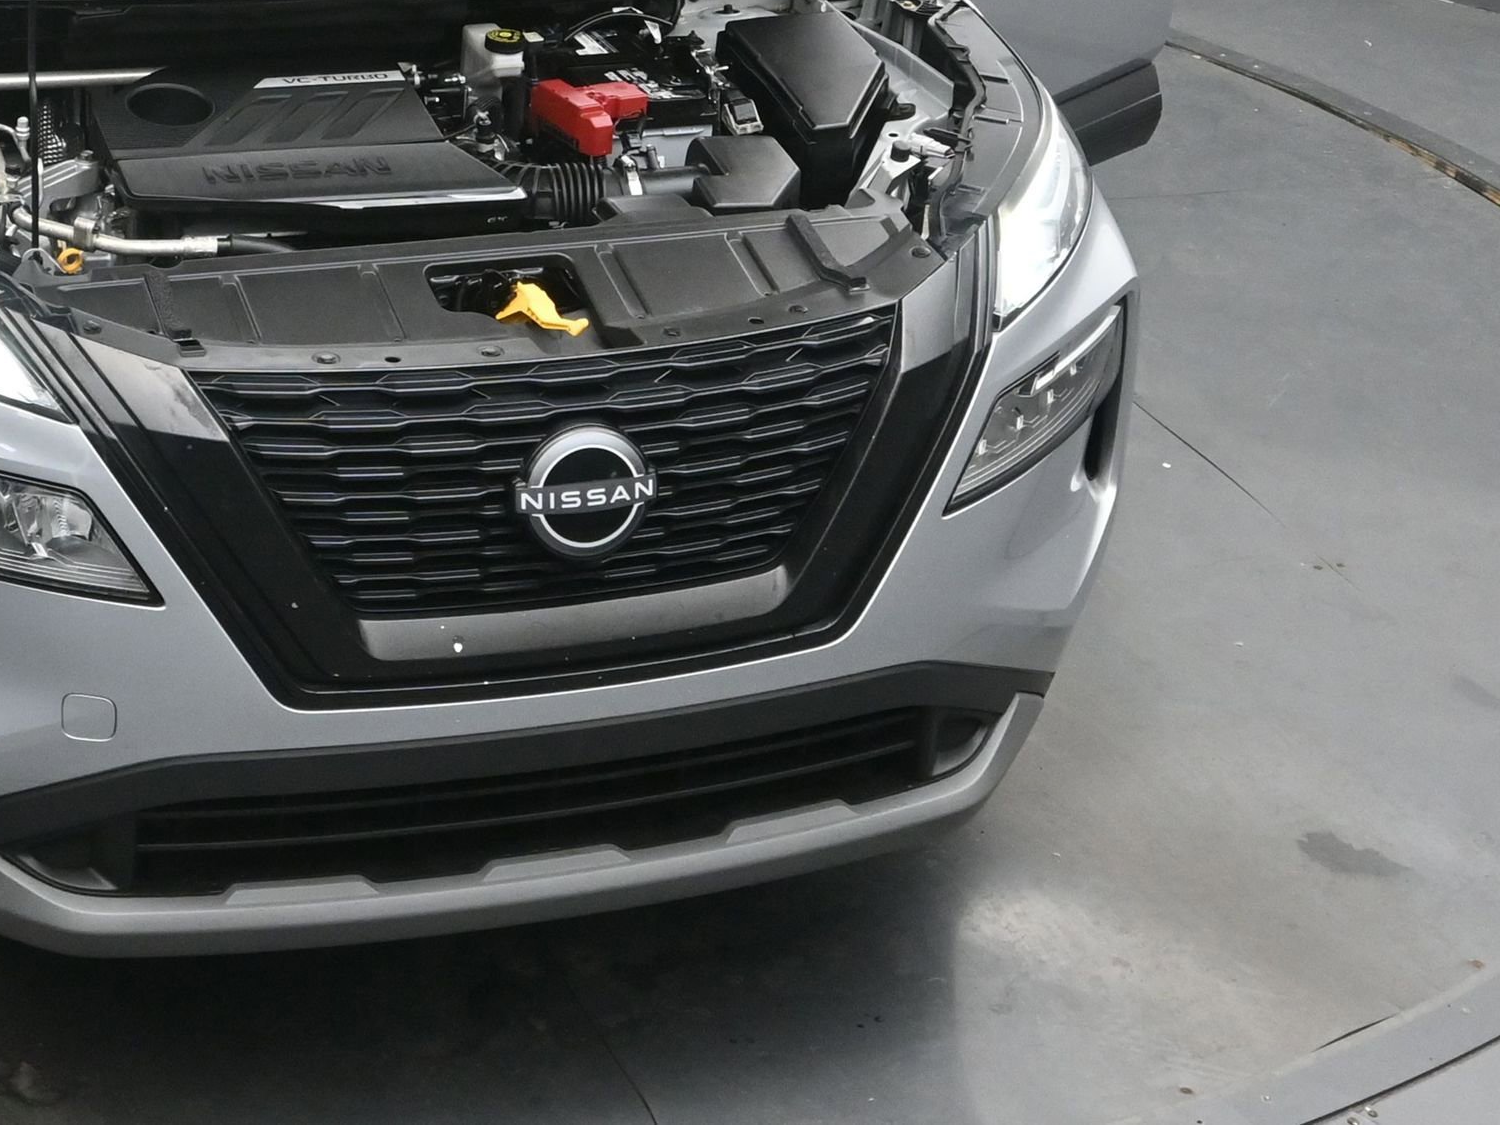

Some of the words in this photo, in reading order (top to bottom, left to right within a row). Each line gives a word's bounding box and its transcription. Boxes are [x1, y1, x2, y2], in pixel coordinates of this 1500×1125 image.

[282, 73, 389, 84] VC-TURBO
[202, 156, 392, 185] NISSAN
[520, 479, 653, 510] NISSAN
